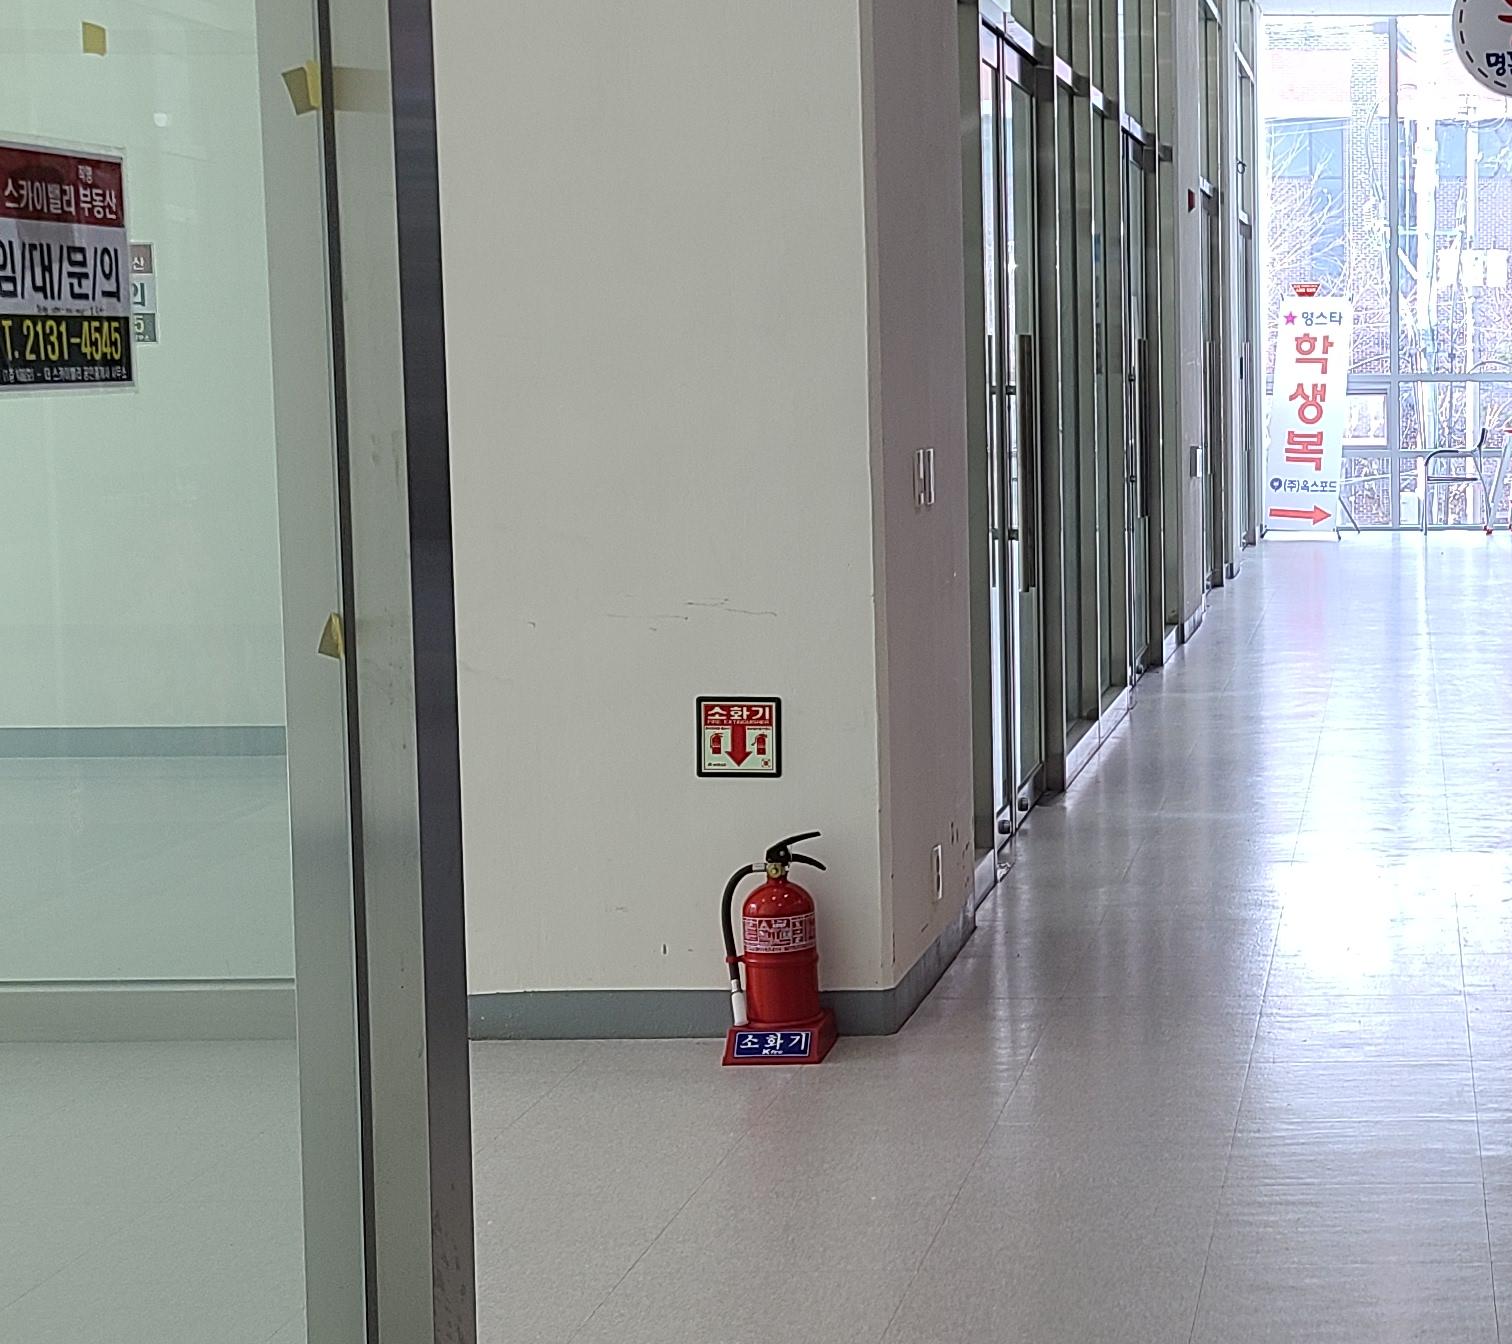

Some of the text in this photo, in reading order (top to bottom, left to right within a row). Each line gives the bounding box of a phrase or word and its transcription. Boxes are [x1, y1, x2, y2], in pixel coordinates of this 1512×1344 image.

[80, 186, 117, 219] 부동산
[1301, 311, 1343, 327] 영스타
[23, 319, 121, 361] 2131-4545
[1283, 478, 1337, 493] (주)옥스포드
[707, 706, 770, 721] 소화기
[739, 1031, 807, 1051] 소화기
